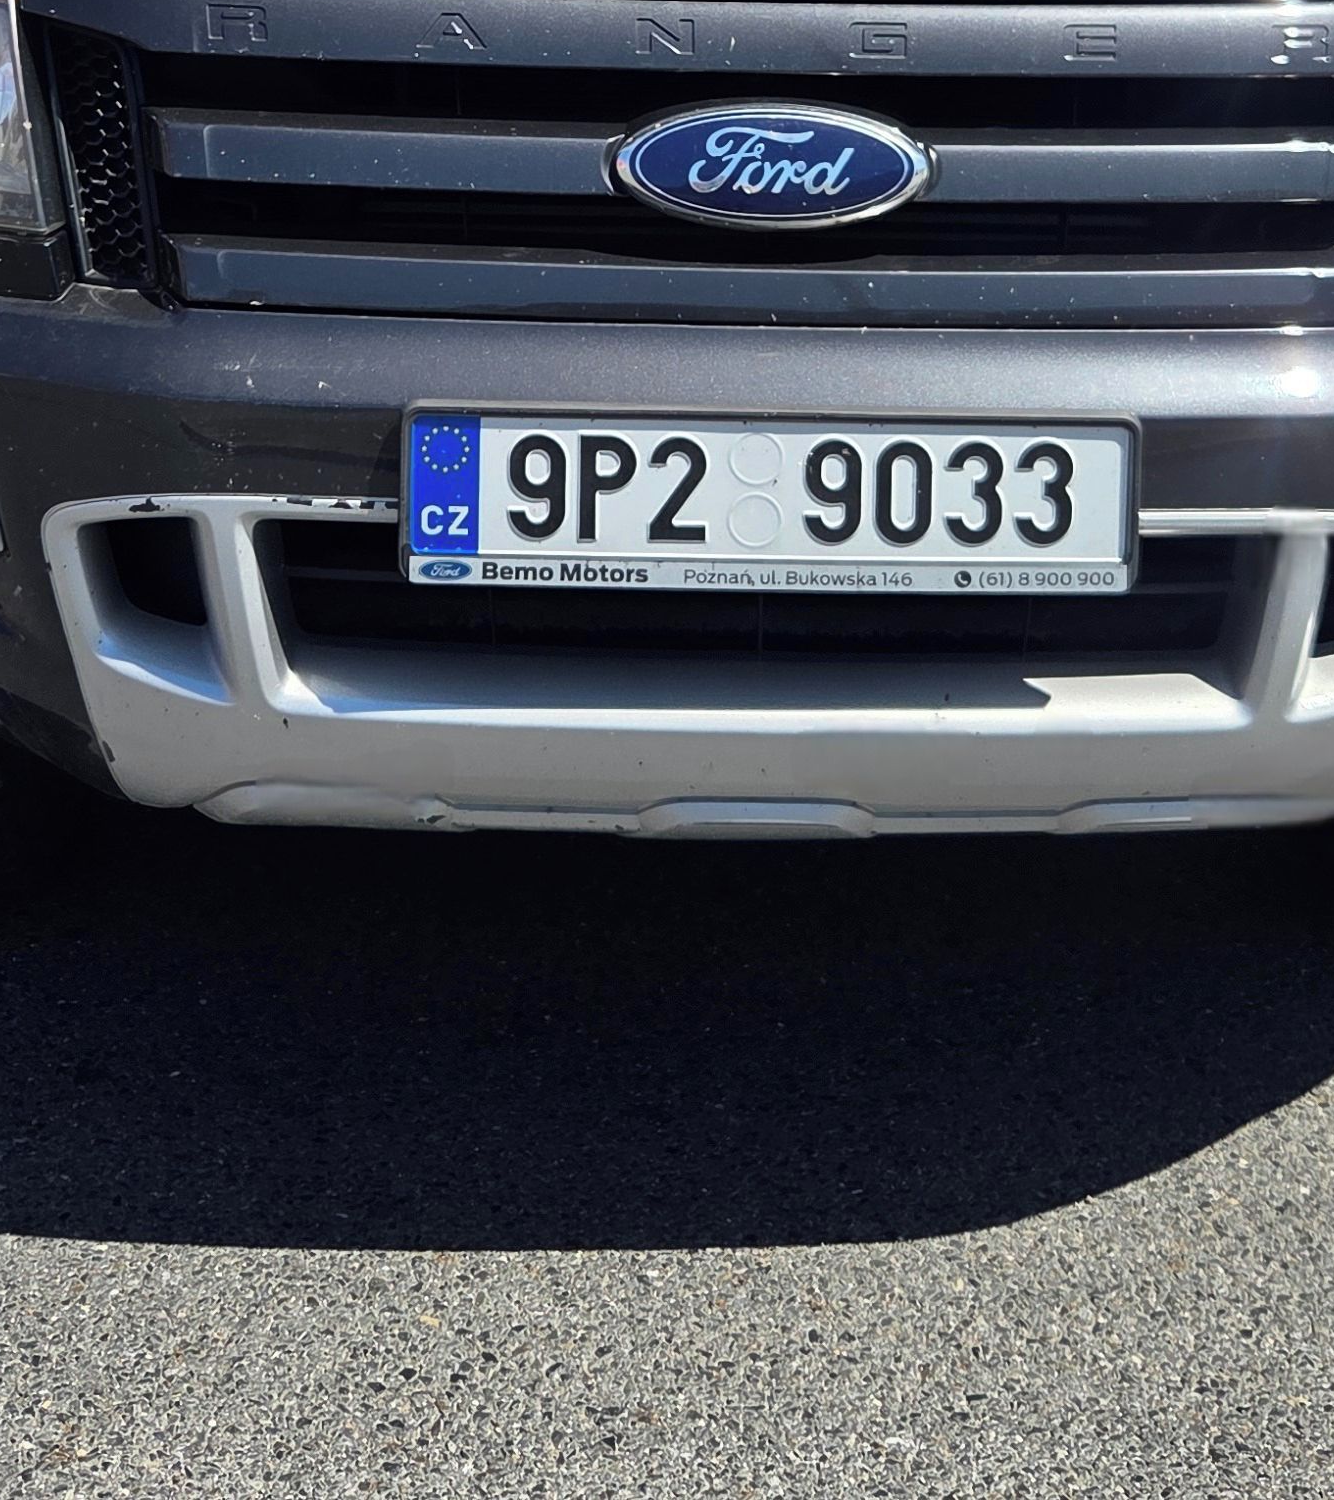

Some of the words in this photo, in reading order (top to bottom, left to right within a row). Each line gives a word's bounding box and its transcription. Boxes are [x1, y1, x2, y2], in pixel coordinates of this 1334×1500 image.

[204, 2, 1331, 65] RANGER
[688, 126, 855, 197] Ford
[507, 432, 708, 543] 9P2
[802, 439, 1074, 547] 9033
[421, 505, 469, 536] CZ
[430, 563, 460, 577] Ford
[482, 562, 553, 581] Bemo
[560, 563, 649, 583] Motors
[759, 570, 781, 586] ul.
[785, 571, 876, 587] Bukowska
[882, 571, 913, 587] 146
[978, 570, 1013, 588] (61)
[1018, 571, 1030, 586] 8
[1034, 571, 1072, 586] 900
[1077, 571, 1115, 586] 900
